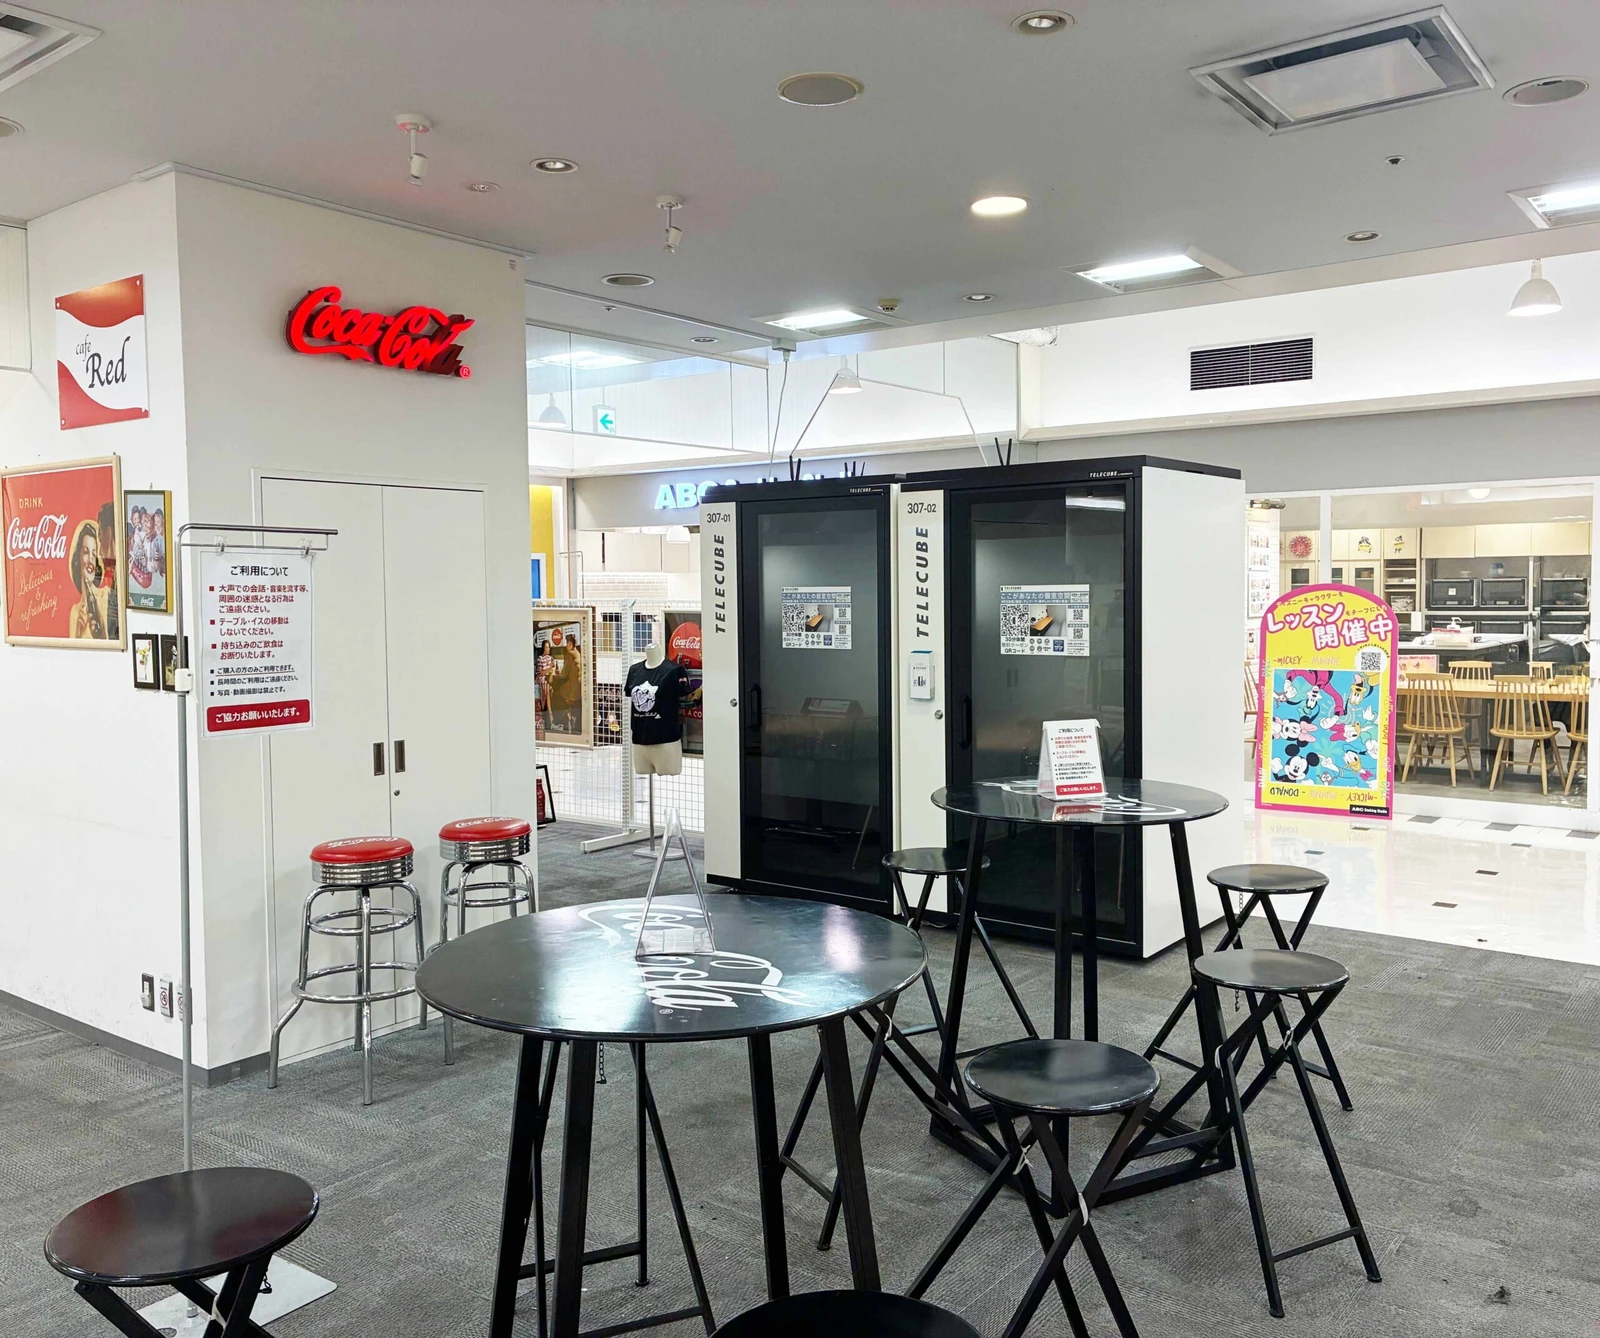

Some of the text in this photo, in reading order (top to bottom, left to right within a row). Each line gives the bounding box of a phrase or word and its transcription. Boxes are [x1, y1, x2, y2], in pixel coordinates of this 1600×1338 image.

[287, 286, 474, 375] Coca-Cola
[75, 334, 92, 361] cafe
[86, 336, 131, 388] Red
[19, 497, 43, 509] DRINK
[907, 503, 937, 514] 307-02
[707, 513, 731, 523] 307-01
[7, 514, 68, 561] Coca-Cola
[230, 565, 289, 577] ご利用について
[18, 570, 54, 597] Delicious
[714, 534, 726, 634] TELECUBE
[916, 526, 929, 638] TELECUBE
[35, 587, 41, 602] &
[20, 596, 58, 630] refreshing
[219, 605, 271, 614] ご遠慮ください。
[1266, 602, 1345, 633] レッスン
[219, 627, 274, 636] しないでください。
[1313, 614, 1393, 650] 開催中
[220, 640, 284, 650] 持ち込みのご飲食は
[220, 650, 276, 660] お断りいたします。
[1276, 656, 1302, 665] MICKEY
[215, 707, 300, 723] ご協力お願いいたします。
[1269, 787, 1299, 797] DONALD
[1347, 792, 1373, 802] MICKEY
